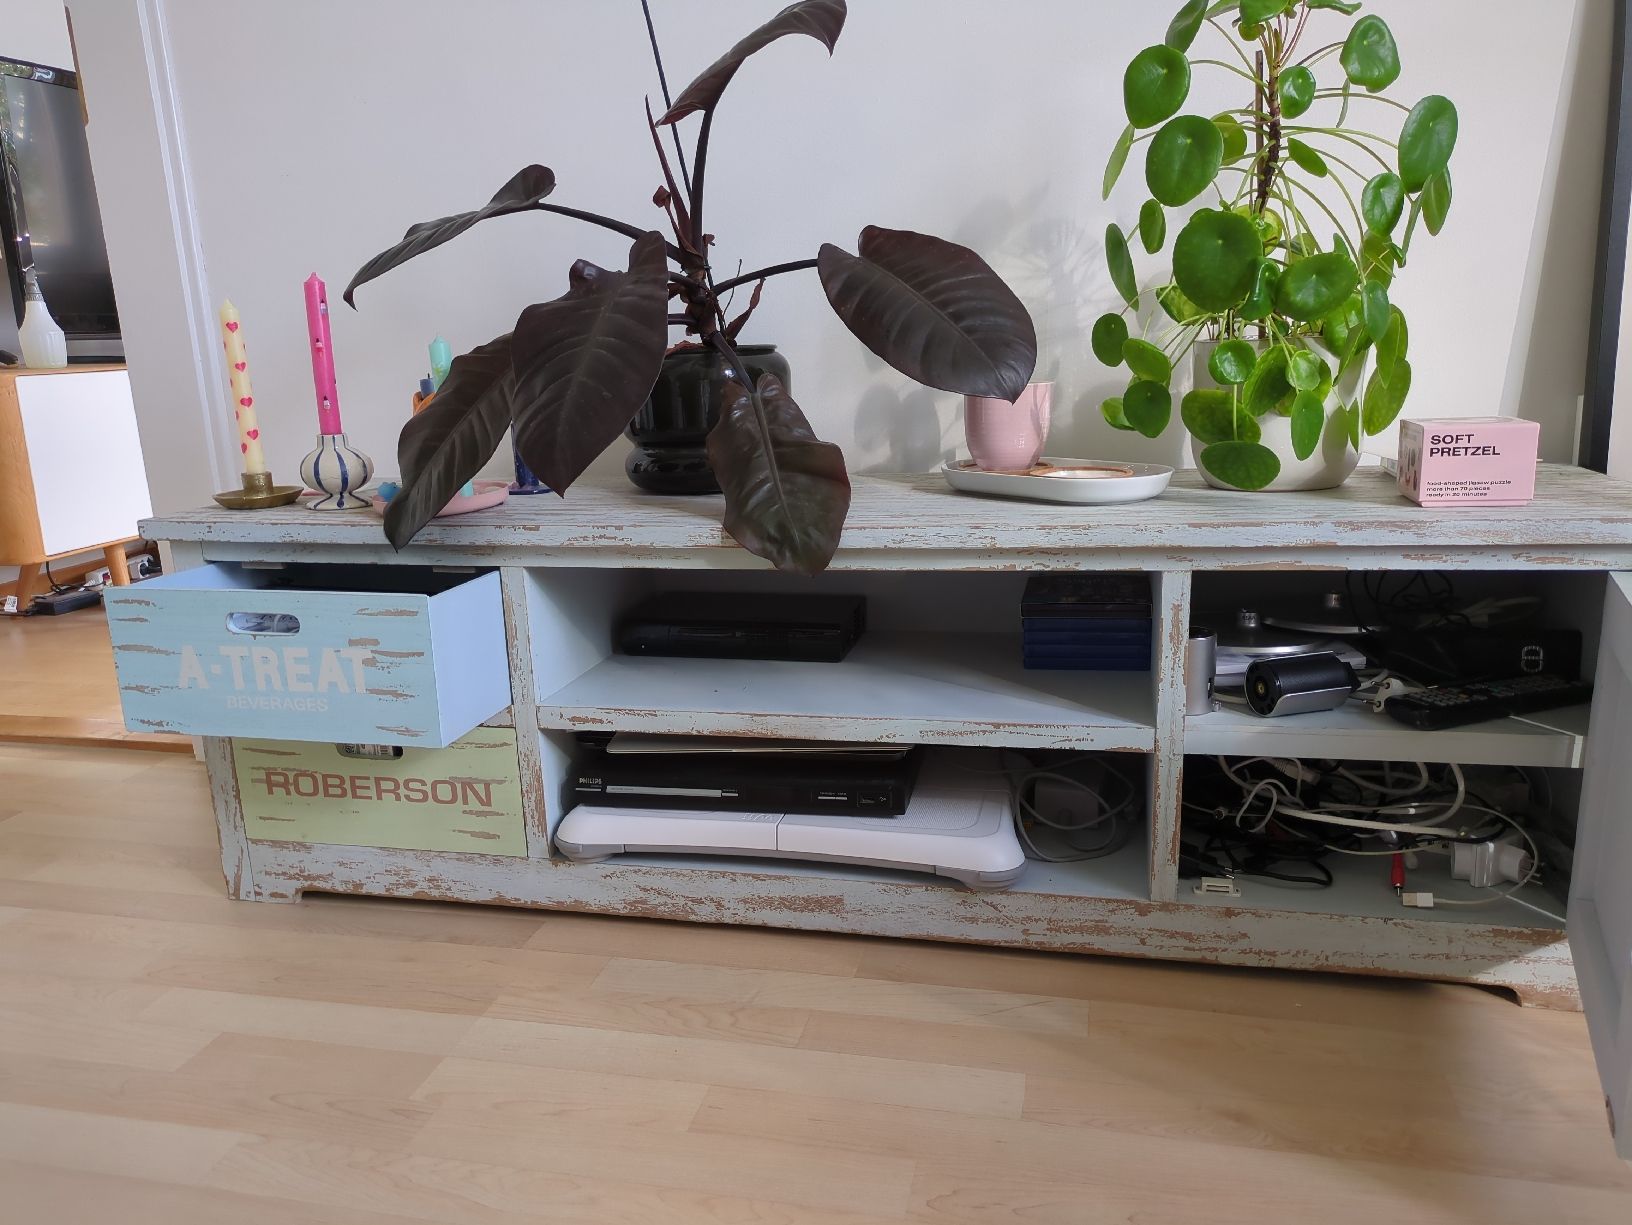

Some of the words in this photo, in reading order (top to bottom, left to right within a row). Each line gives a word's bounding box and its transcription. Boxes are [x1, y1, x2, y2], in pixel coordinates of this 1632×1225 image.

[1430, 434, 1474, 445] SOFT
[1430, 446, 1501, 458] PRETZEL
[226, 695, 329, 712] BEVERAGES
[579, 777, 602, 785] PHILIPS
[265, 770, 493, 808] ROBERSON
